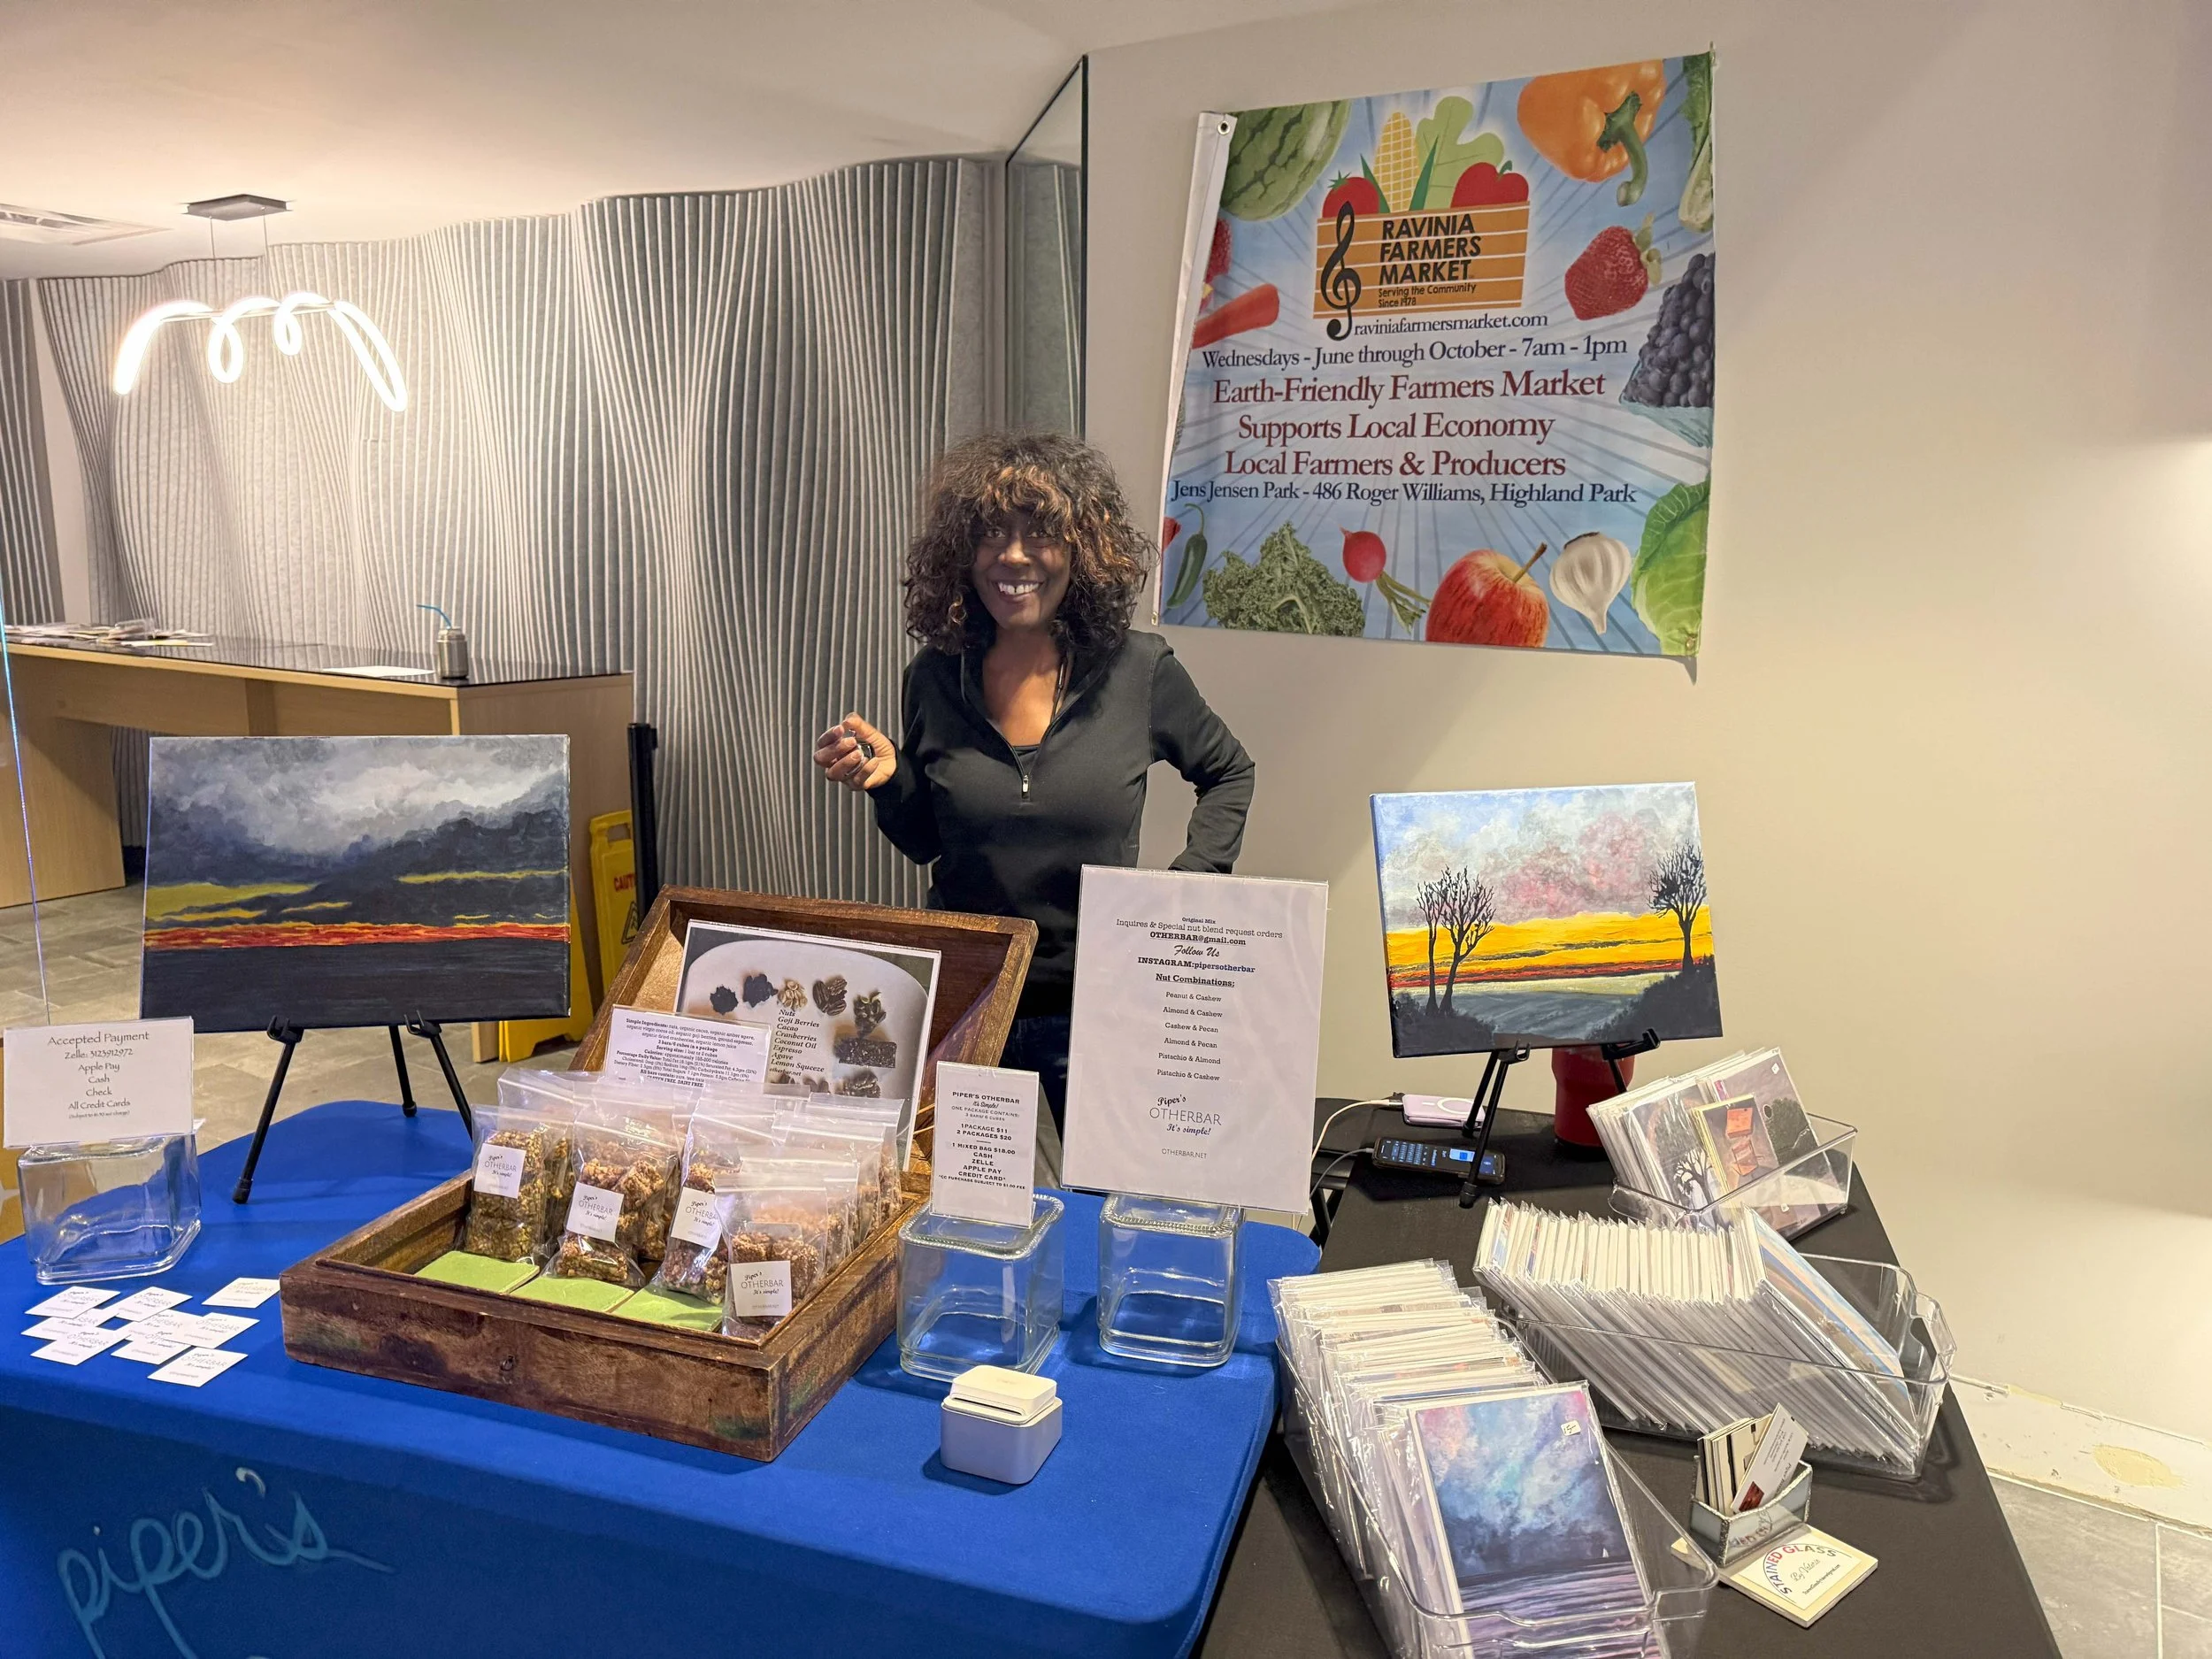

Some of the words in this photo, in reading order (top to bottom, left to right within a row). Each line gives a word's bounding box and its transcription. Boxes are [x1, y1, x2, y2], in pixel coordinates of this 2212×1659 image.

[1382, 213, 1475, 241] RAVINIA
[1380, 235, 1482, 263] FARMERS
[1379, 259, 1472, 286] MARKET
[1379, 287, 1409, 299] Serving
[1411, 285, 1425, 296] the
[1426, 282, 1477, 295] Community
[1379, 298, 1399, 308] Since
[1400, 297, 1417, 306] 1978
[1354, 313, 1548, 336] raviniafarmersmarket.com
[1202, 349, 1300, 372] Wednesdays
[1312, 347, 1354, 371] June
[1358, 342, 1425, 368] through
[1429, 340, 1506, 360] October
[1522, 337, 1565, 356] 7am
[1583, 335, 1627, 361] 1pm
[1213, 375, 1385, 409] Earth-Friendly
[1389, 373, 1494, 399] Farmers
[1501, 368, 1607, 397] Market
[1239, 414, 1341, 448] Supports
[1347, 412, 1417, 439] Local
[1422, 412, 1555, 445] Economy
[1224, 449, 1286, 475] Local
[1292, 450, 1393, 476] Farmers
[1400, 451, 1425, 476] &
[1431, 449, 1566, 477] Producers
[1171, 480, 1206, 502] Jens
[1207, 480, 1259, 503] Jensen
[1263, 481, 1300, 499] Park
[1312, 482, 1341, 500] 486
[1346, 482, 1399, 507] Roger
[1402, 483, 1485, 505] Williams,
[1489, 483, 1583, 508] Highland
[1588, 483, 1637, 503] Park
[1117, 918, 1148, 929] Inquires
[1158, 922, 1186, 932] Special
[1202, 926, 1224, 934] blend
[1225, 928, 1255, 938] request
[1150, 932, 1246, 946] OTHERBAR@gmail.com
[1174, 945, 1203, 956] Follow
[1206, 947, 1220, 957] Us
[1138, 956, 1256, 972] INSTAGRAM:pipersotherbar
[1156, 973, 1171, 982] Nut
[795, 1018, 819, 1028] Berries
[48, 1032, 101, 1048] Accepted
[104, 1032, 150, 1047] Payment
[775, 1031, 817, 1041] Cranberries
[772, 1045, 803, 1054] Espresso
[774, 1038, 803, 1048] Coconut
[65, 1050, 88, 1060] Zelle:
[1158, 1052, 1187, 1061] Pistachio
[1194, 1056, 1221, 1064] Almond
[78, 1062, 104, 1074] Apple
[104, 1063, 120, 1072] Pay
[771, 1058, 795, 1068] Lemon
[795, 1063, 825, 1072] Squeeze
[88, 1074, 110, 1084] Cash
[1156, 1069, 1186, 1078] Pistachio
[1194, 1072, 1220, 1081] Cashew
[86, 1087, 112, 1096] Check
[80, 1100, 105, 1109] Credit
[106, 1098, 131, 1108] Cards
[981, 1094, 1020, 1104] OTHERBAR
[1157, 1094, 1187, 1107] Piper's
[1149, 1107, 1222, 1125] OTHERBAR
[962, 1130, 998, 1139] PACKAGES
[1167, 1123, 1180, 1132] It's
[1182, 1125, 1211, 1136] simple!
[1161, 1148, 1207, 1159] OTHERBAR.NET
[579, 1200, 613, 1215] OTHERBAR
[741, 1279, 784, 1288] OTHERBAR
[1765, 1551, 1793, 1594] STAINED
[1782, 1545, 1837, 1557] GLASS
